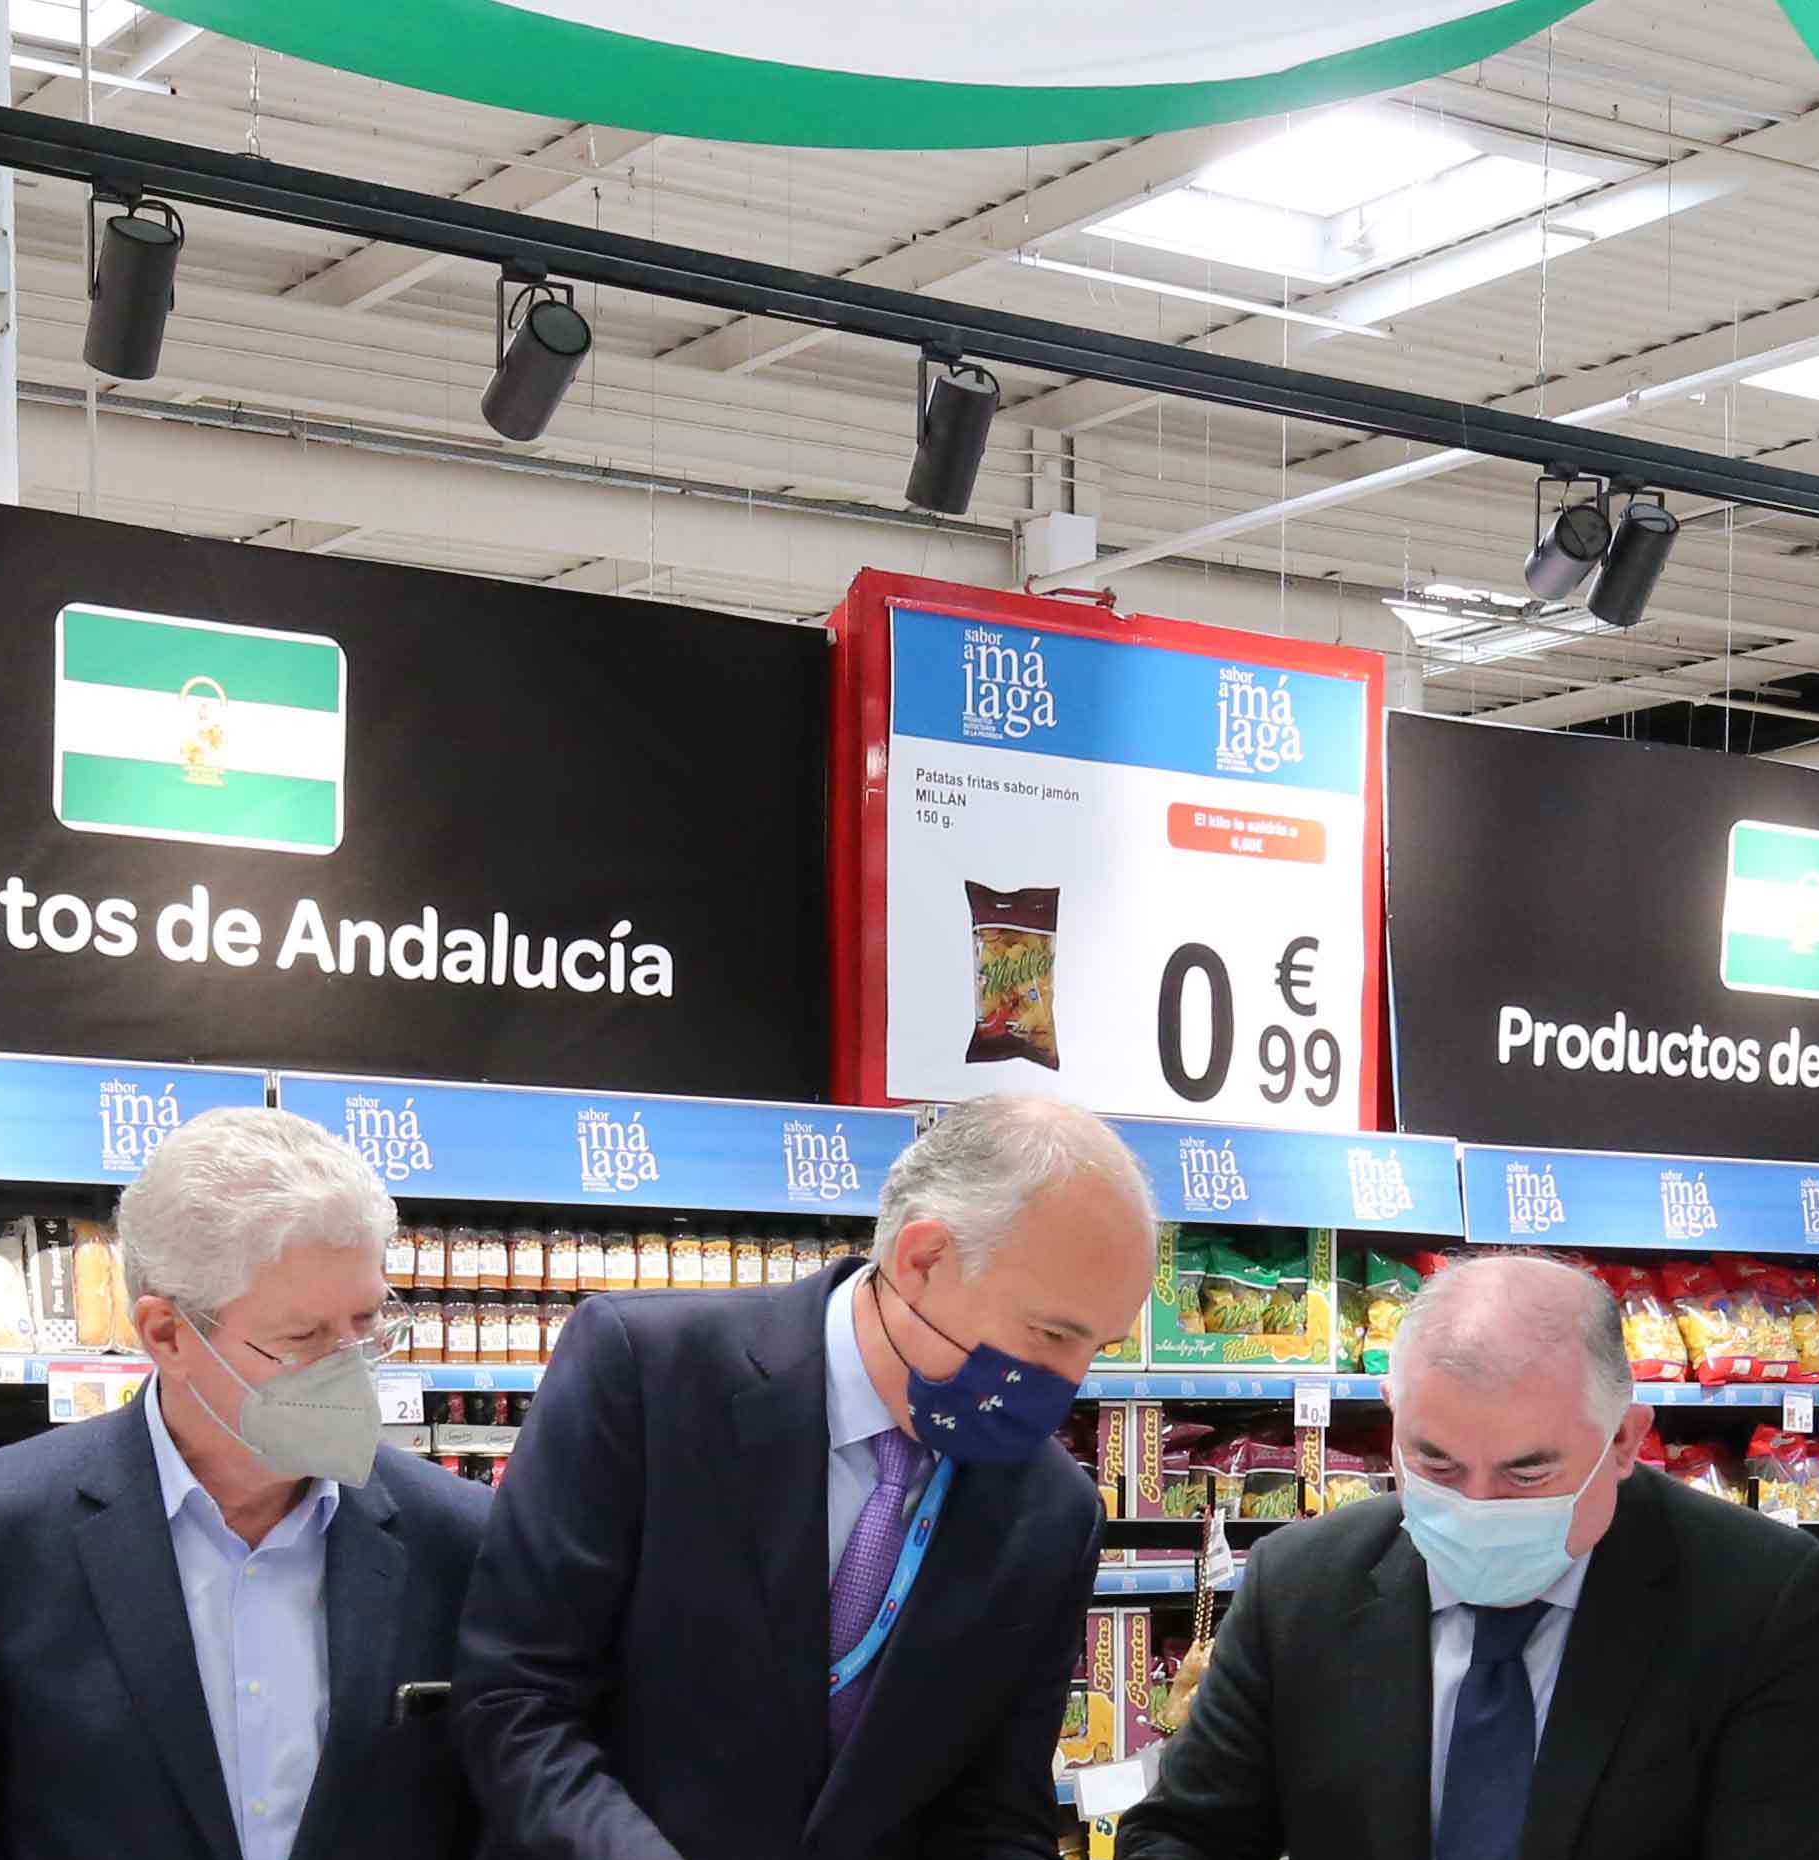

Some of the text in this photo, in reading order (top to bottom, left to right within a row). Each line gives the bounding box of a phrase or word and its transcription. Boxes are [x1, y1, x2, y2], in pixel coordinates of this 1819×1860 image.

[964, 627, 1003, 645] sabor
[976, 635, 1047, 690] má
[1219, 666, 1254, 686] sabor
[962, 664, 1057, 739] laga
[1229, 675, 1292, 727] má
[1216, 701, 1304, 772] laga
[916, 767, 1080, 801] Patatas fritas sabor jamón
[916, 809, 938, 824] 150
[156, 884, 262, 969] de
[277, 893, 676, 1001] Andalucía
[1157, 936, 1320, 1103] 0 €
[1258, 1024, 1341, 1107] 99
[1497, 1006, 1760, 1086] Productos
[100, 1079, 138, 1096] sabor
[114, 1083, 182, 1128] má
[346, 1094, 380, 1109] sabor
[359, 1097, 422, 1140] má
[578, 1107, 610, 1122] sabor
[589, 1111, 649, 1152] má
[783, 1119, 812, 1134] sabor
[578, 1137, 660, 1191] laga
[794, 1124, 852, 1163] má
[1190, 1139, 1239, 1177] má
[783, 1147, 860, 1199] laga
[1181, 1162, 1249, 1210] laga
[1516, 1164, 1559, 1198] má
[1667, 1170, 1710, 1207] má
[1507, 1184, 1566, 1232] laga
[1661, 1192, 1718, 1237] laga
[51, 1288, 64, 1313] Pan
[397, 1401, 409, 1419] 2
[1139, 1407, 1162, 1504] Patatas
[1093, 1616, 1113, 1693] Fritas
[1125, 1615, 1149, 1710] Patatas
